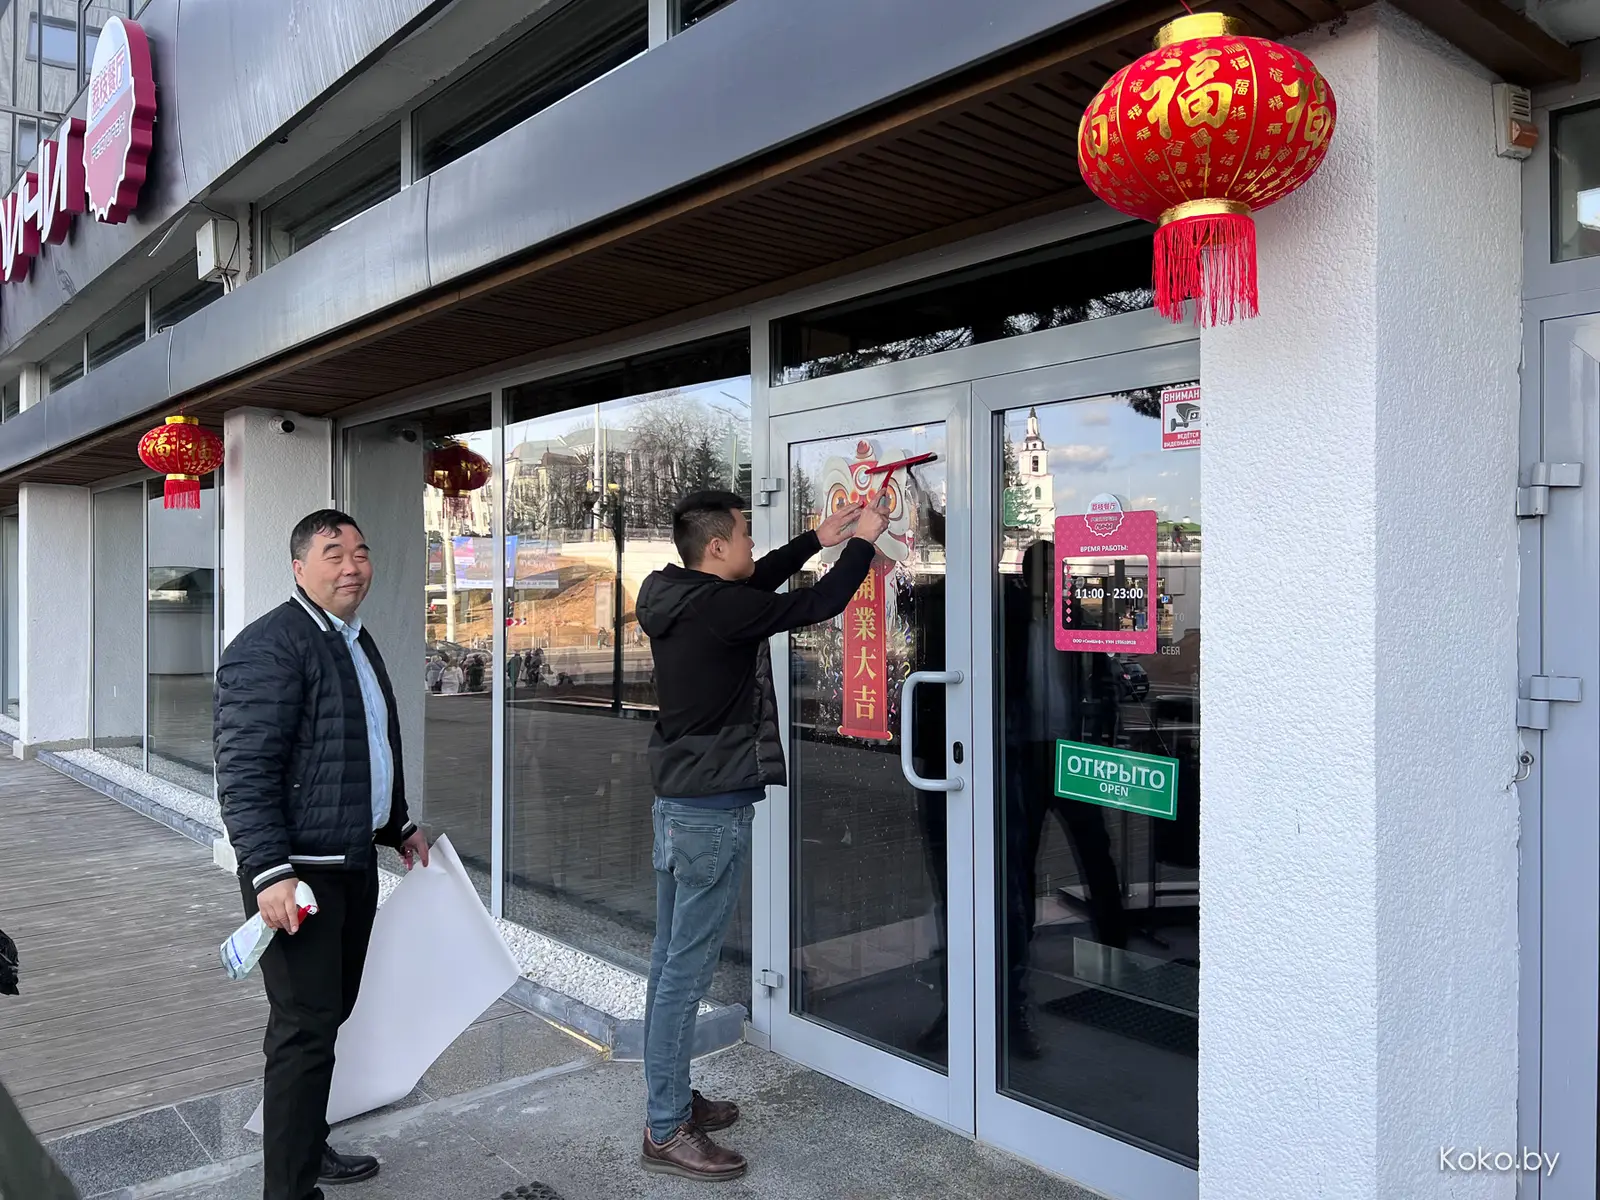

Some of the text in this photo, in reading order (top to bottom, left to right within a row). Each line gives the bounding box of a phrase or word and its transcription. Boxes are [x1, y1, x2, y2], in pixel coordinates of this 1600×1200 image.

[1140, 49, 1232, 139] 福
[1164, 389, 1199, 402] ВНИМАН
[147, 433, 170, 457] 福
[1164, 439, 1200, 447] ВИДЕОНАБЛЮД
[1075, 588, 1104, 599] 11:00
[1113, 588, 1143, 599] 23:00
[1161, 646, 1181, 655] СЕБЯ
[1067, 755, 1165, 789] ОТКРЫТО
[1099, 782, 1129, 797] OPEN
